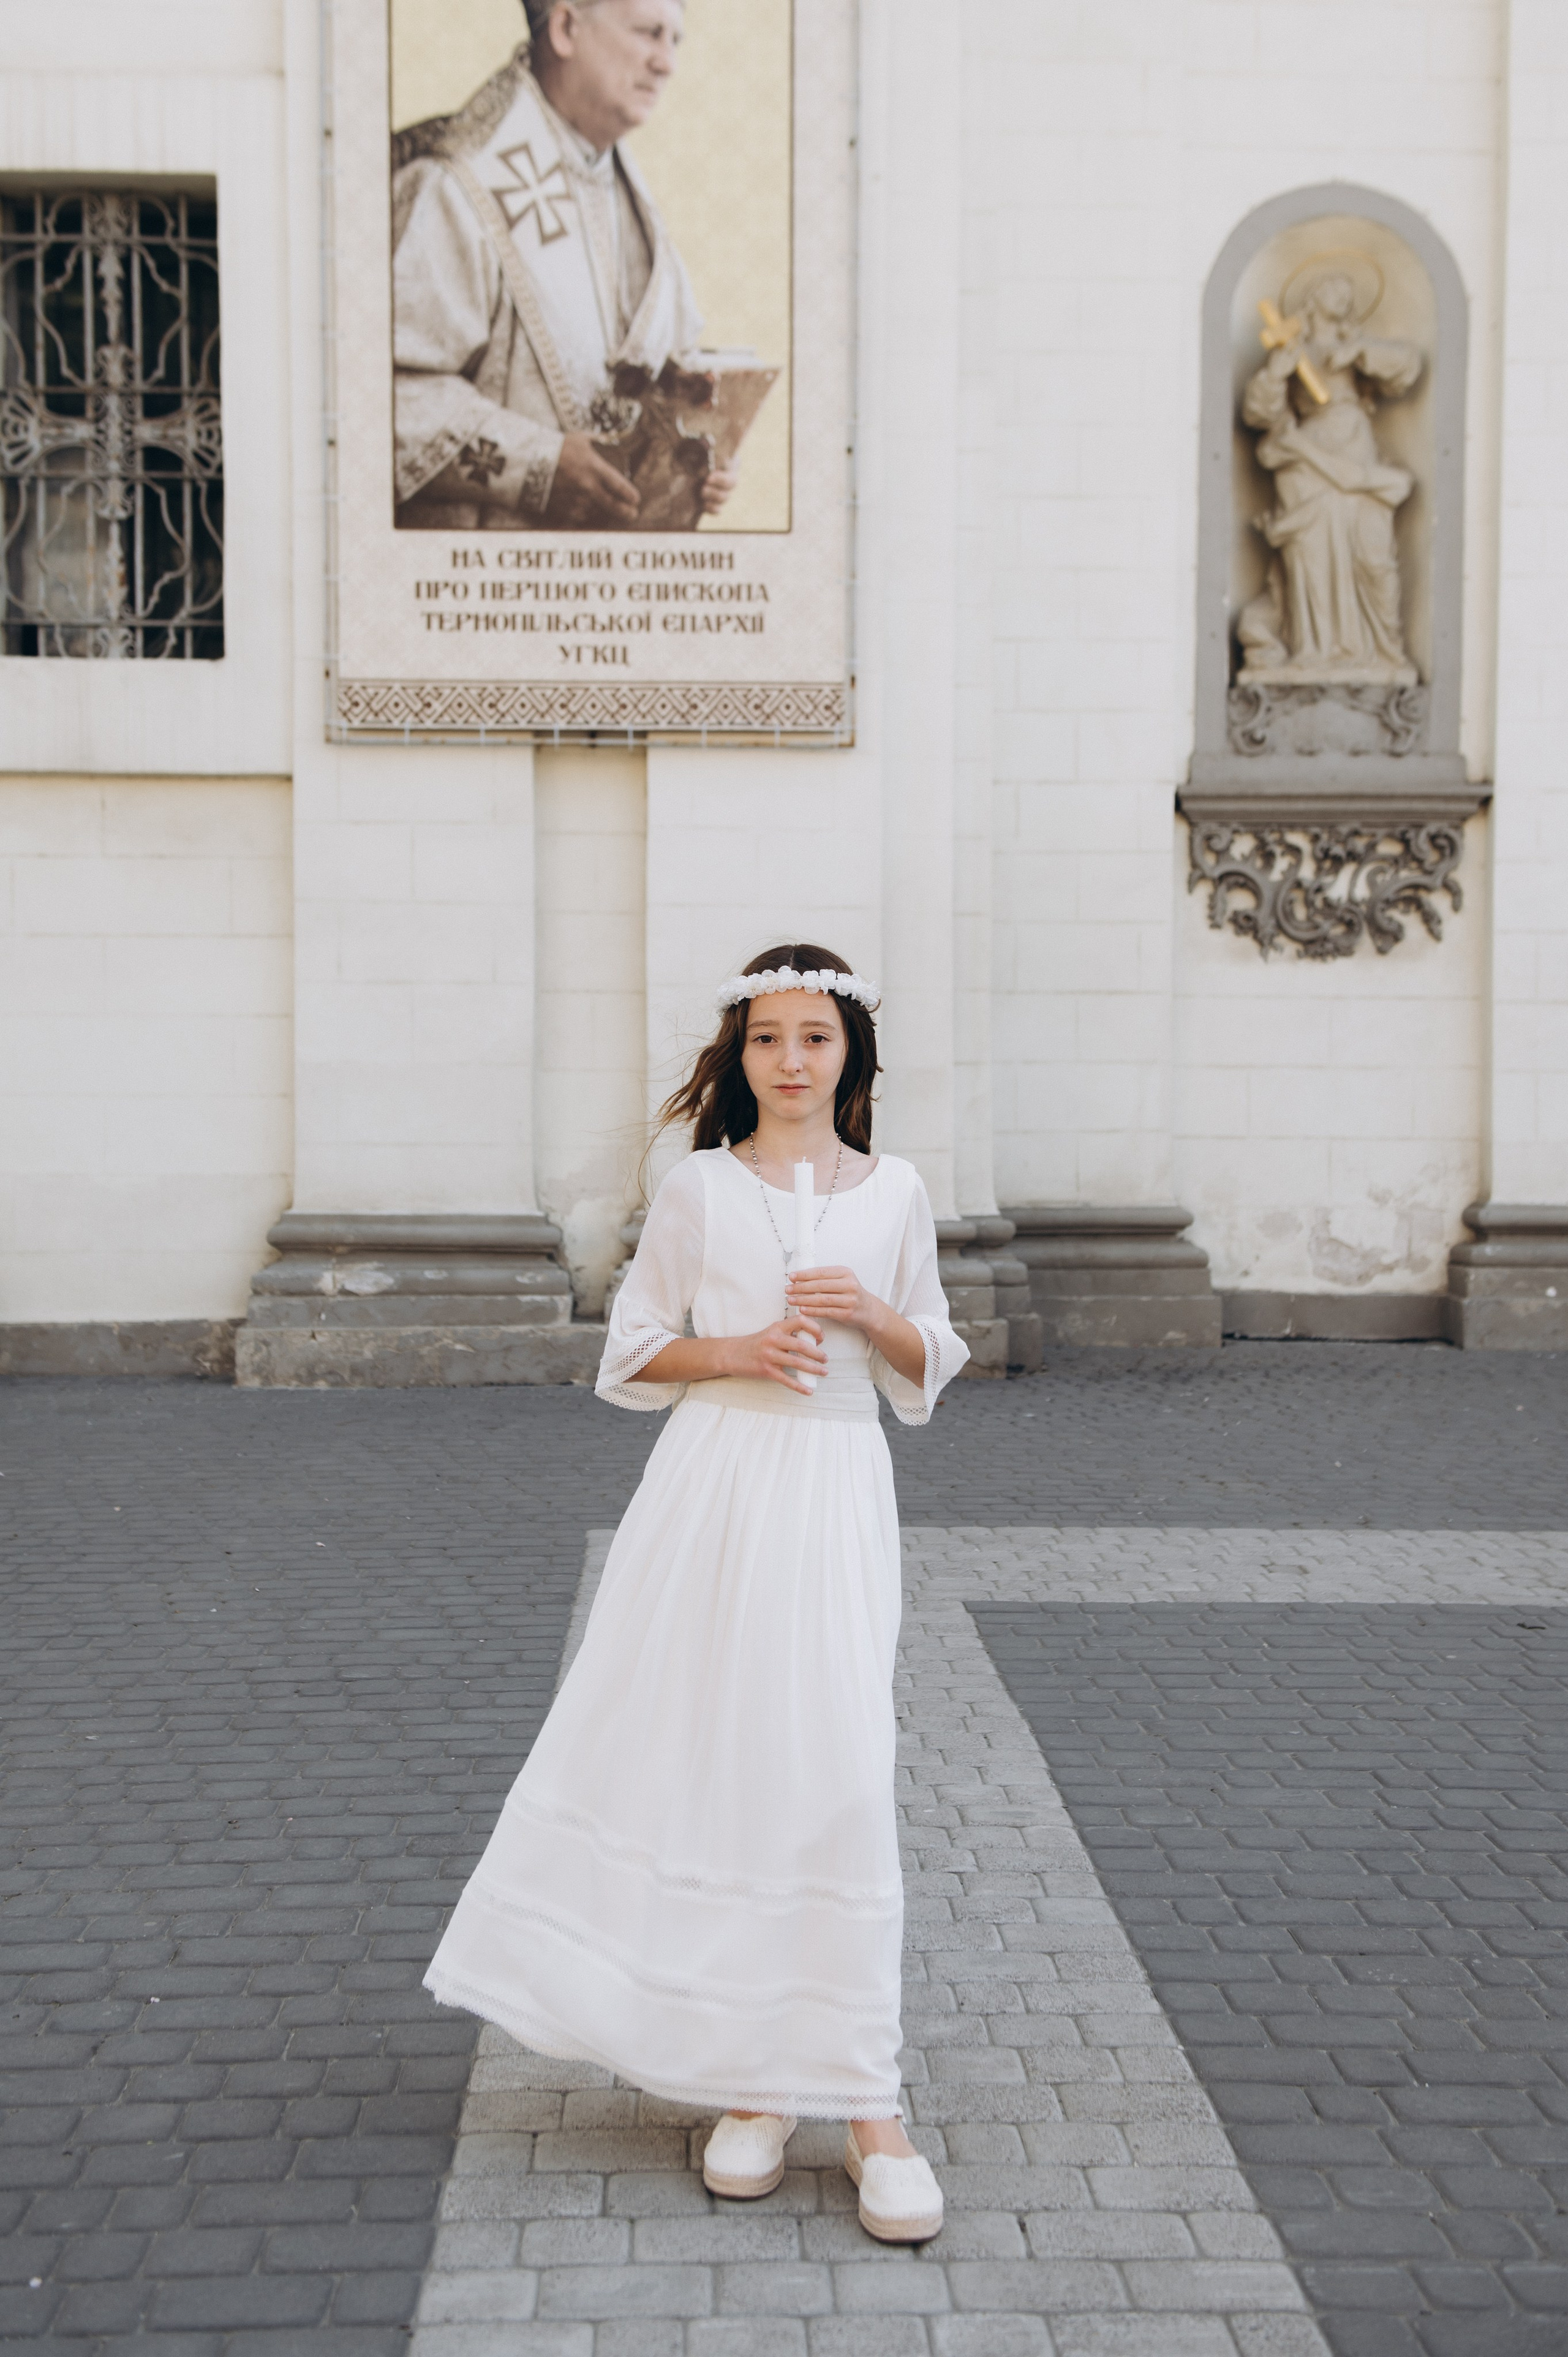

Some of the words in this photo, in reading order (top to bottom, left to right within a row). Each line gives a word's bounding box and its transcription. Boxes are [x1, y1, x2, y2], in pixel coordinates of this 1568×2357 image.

[451, 549, 486, 569] НА
[497, 547, 612, 570] СВІТЛИЙ
[623, 550, 734, 570] СПОМИН
[415, 581, 469, 600] ПРО
[481, 582, 616, 601] ПЕРШОГО
[627, 583, 770, 602] ЄПИСКОПА
[421, 610, 651, 633] ТЕРНОПІЛЬСЬКОЇ
[662, 611, 765, 634] ЄПАРХІЇ
[558, 645, 629, 666] УГКЦ
